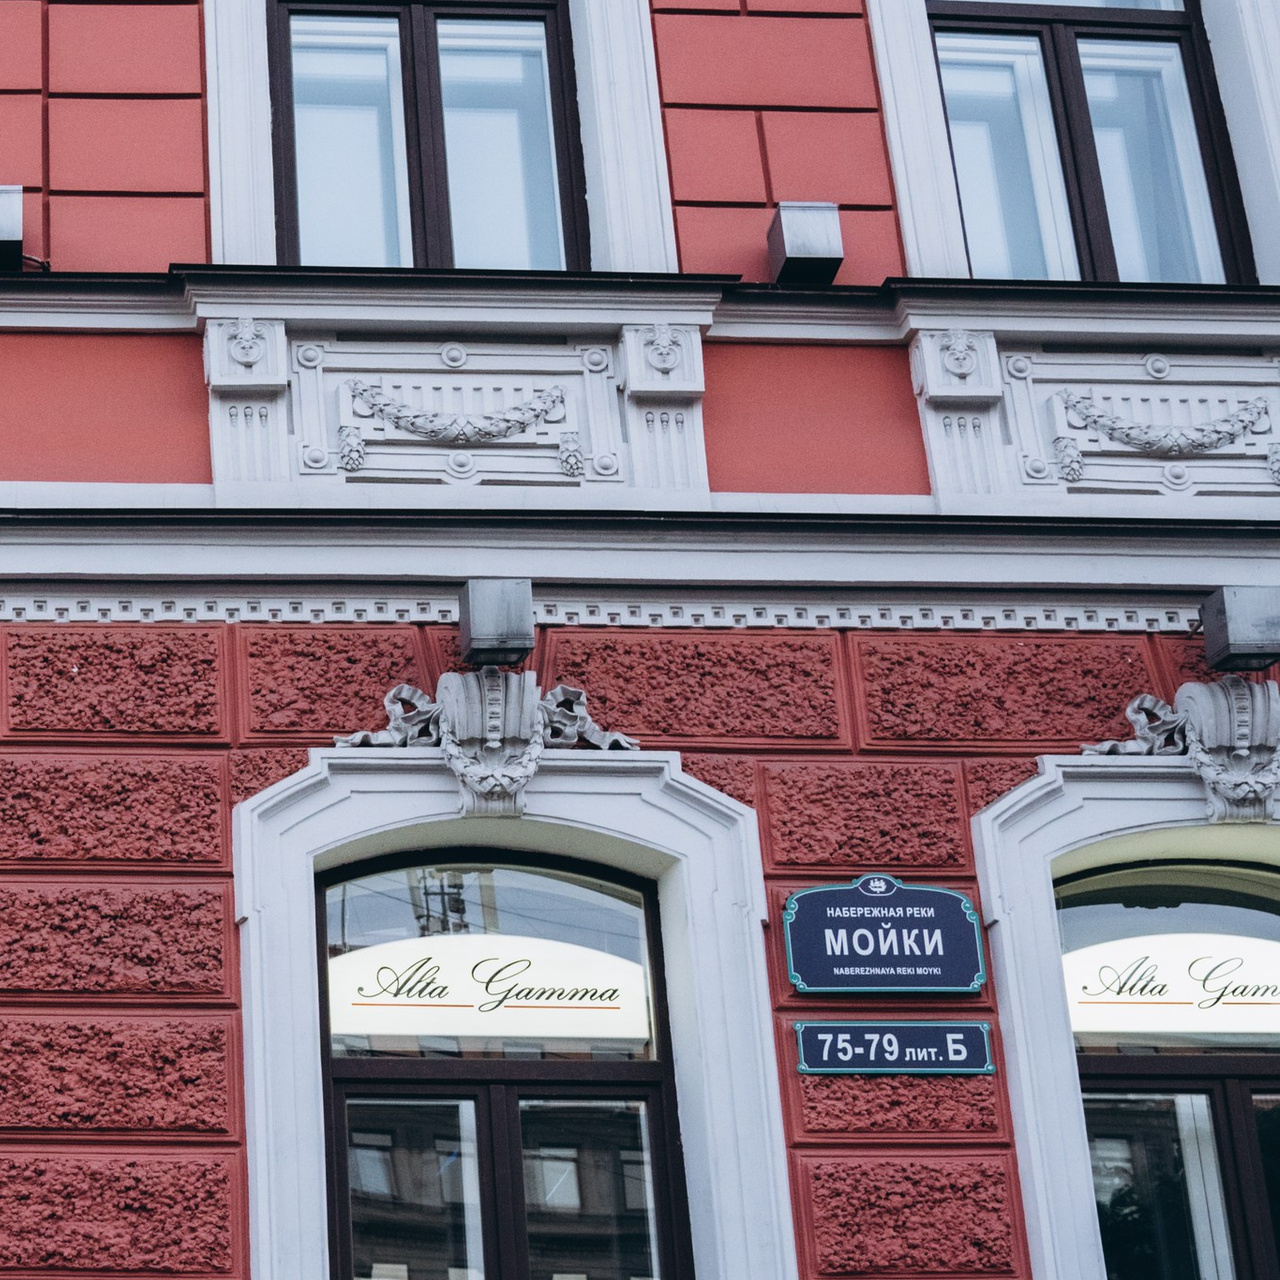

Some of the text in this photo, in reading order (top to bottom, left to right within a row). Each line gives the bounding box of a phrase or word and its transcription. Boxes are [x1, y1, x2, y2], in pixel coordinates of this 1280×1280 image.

[826, 907, 935, 918] НАБЕРЕЖНАЯ РЕКИ
[824, 922, 944, 956] МОЙКИ
[357, 956, 620, 1013] Alta Gamma
[833, 967, 941, 975] NABEREZHNAYA REKI MOYKI
[1081, 955, 1169, 997] Alta
[817, 1033, 968, 1061] 75-79 лит. Б
